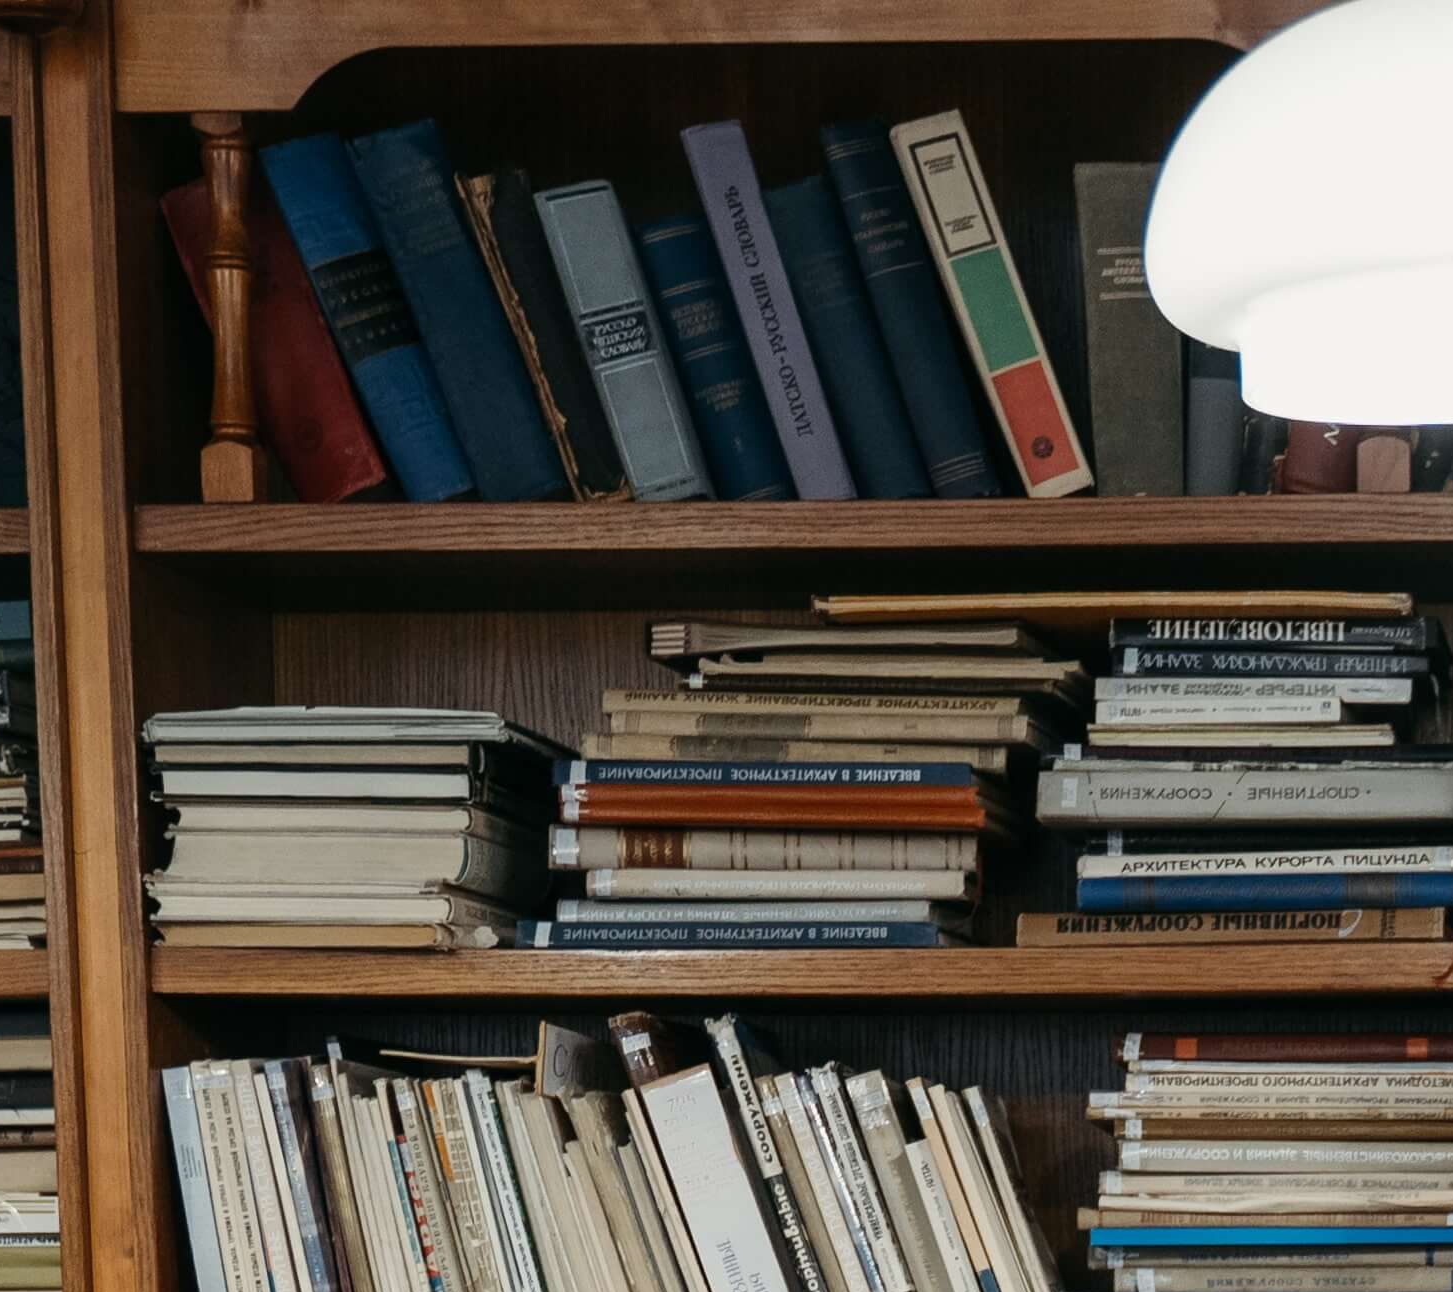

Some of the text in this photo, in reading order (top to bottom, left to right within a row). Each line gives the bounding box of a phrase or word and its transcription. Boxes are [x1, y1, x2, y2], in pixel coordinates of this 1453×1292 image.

[721, 183, 761, 270] СЛОВАРЬ
[1145, 617, 1346, 642] ЦВЕТОВЕДЕНИЕ
[1211, 653, 1326, 671] ГРАЖДАНСКИХ
[1255, 683, 1336, 697] ИНТЕРЬЕР
[623, 690, 871, 706] ПРОЕКТИРОВАНИЕ ЖИЛЫХ ЗДАНИЙ
[875, 696, 996, 711] АРХИТЕКТУРНОЕ
[597, 766, 722, 780] ПРОЕКТИРОВАНИЕ
[728, 767, 837, 781] АРХИТЕКТУРНОЕ
[854, 768, 920, 781] ВВЕДЕНИЕ
[1098, 786, 1359, 799] СПОРТИВНЫЕ СООРУЖЕНИЯ
[1120, 852, 1430, 873] АРХИТЕКТУРА КУРОРТА ПИЦУНДА
[823, 923, 887, 938] ВВЕДЕНИЕ
[1056, 914, 1203, 933] СООРУЖЕНИЯ
[562, 927, 687, 941] ПРОЕКТИРОВАНИЕ
[696, 927, 804, 940] АРХИТЕКТУРНОЕ
[1147, 1075, 1257, 1087] ПРОЕКТИРОВАНИ
[1262, 1075, 1378, 1087] АРХИТЕКТУРНОГО
[725, 1050, 779, 1165] сооружени
[1247, 1149, 1296, 1161] ЗДАНИЯ
